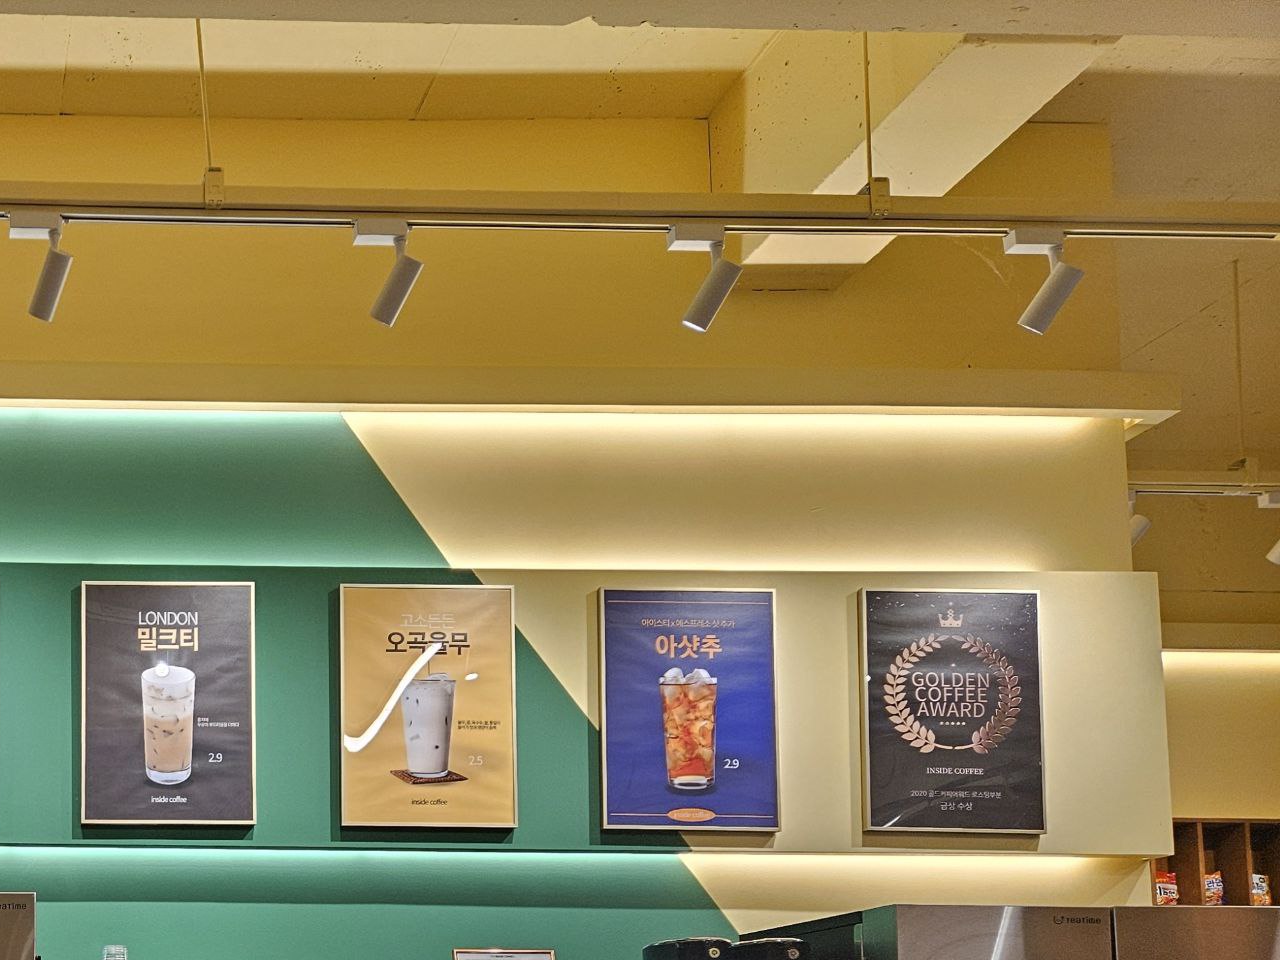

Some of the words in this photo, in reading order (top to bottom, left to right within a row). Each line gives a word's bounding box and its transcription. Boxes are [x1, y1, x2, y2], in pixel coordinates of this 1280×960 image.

[138, 611, 199, 626] LONDON
[137, 627, 199, 652] 밀크티
[385, 631, 471, 655] 오곡율무
[655, 634, 723, 659] 아샷추
[911, 671, 990, 688] GOLDEN
[915, 686, 988, 703] COFFEE
[917, 702, 985, 718] AWARD
[208, 752, 223, 763] 2.9
[468, 755, 483, 766] 2.5
[723, 758, 740, 769] 2.9
[926, 766, 953, 775] INSIDE
[954, 767, 984, 775] COFFEE
[151, 795, 169, 803] inside
[169, 795, 188, 803] coffee
[411, 798, 429, 806] inside
[430, 798, 448, 806] coffee
[941, 801, 955, 811] 금상
[957, 801, 973, 811] 수상
